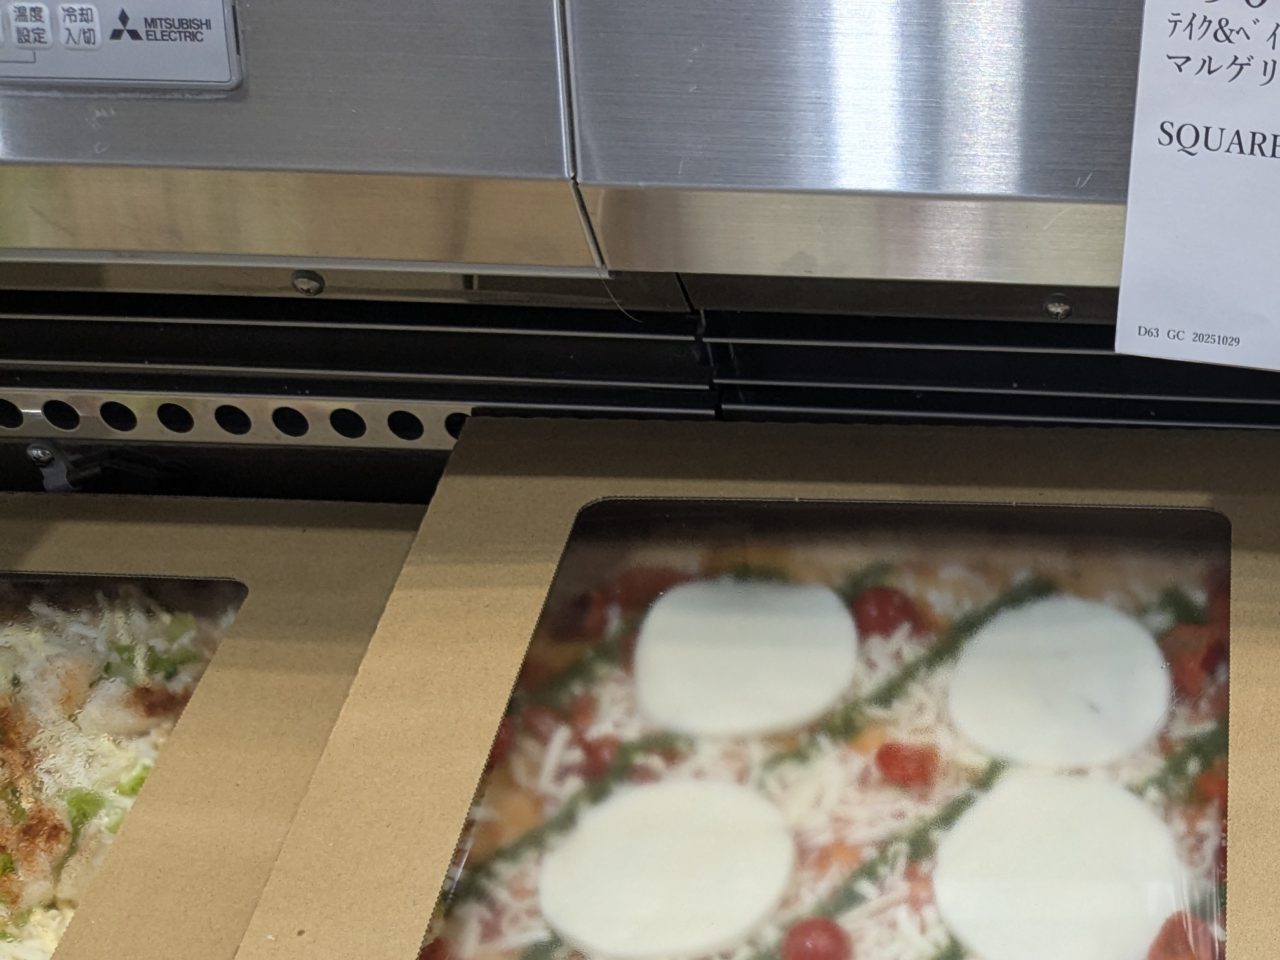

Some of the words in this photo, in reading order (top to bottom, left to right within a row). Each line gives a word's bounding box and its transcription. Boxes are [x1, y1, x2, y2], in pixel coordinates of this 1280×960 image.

[13, 6, 46, 23] 温度
[62, 6, 94, 24] 冷却
[143, 17, 212, 30] MITSUBISHI
[16, 27, 48, 44] 設定
[65, 28, 96, 46] 入/切
[145, 29, 205, 43] ELECTRIC
[1137, 325, 1160, 338] D63
[1166, 329, 1186, 341] GC
[1191, 331, 1241, 347] 20251029
